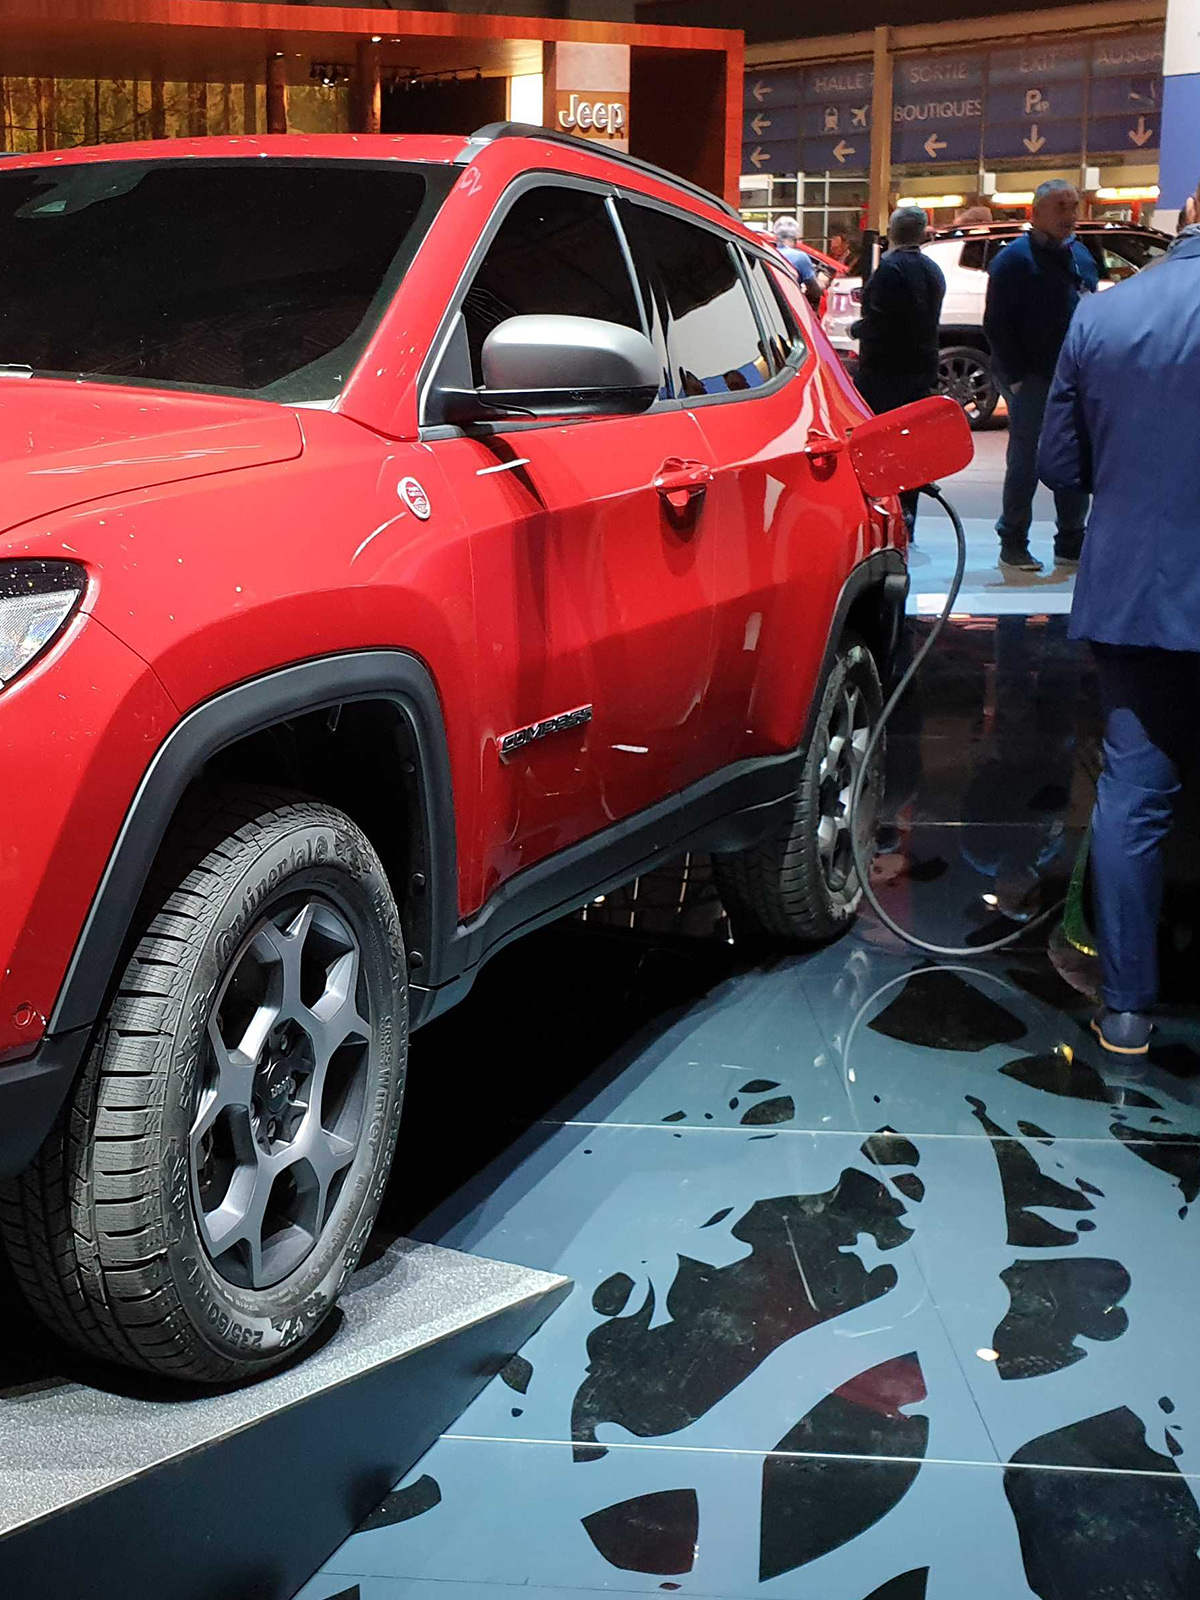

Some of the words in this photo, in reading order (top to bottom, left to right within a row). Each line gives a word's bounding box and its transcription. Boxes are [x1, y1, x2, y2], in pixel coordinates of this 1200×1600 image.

[814, 72, 865, 94] HALLE
[909, 62, 968, 84] SORTIE
[558, 94, 626, 135] Jeep
[894, 99, 982, 122] BOUTIQUES
